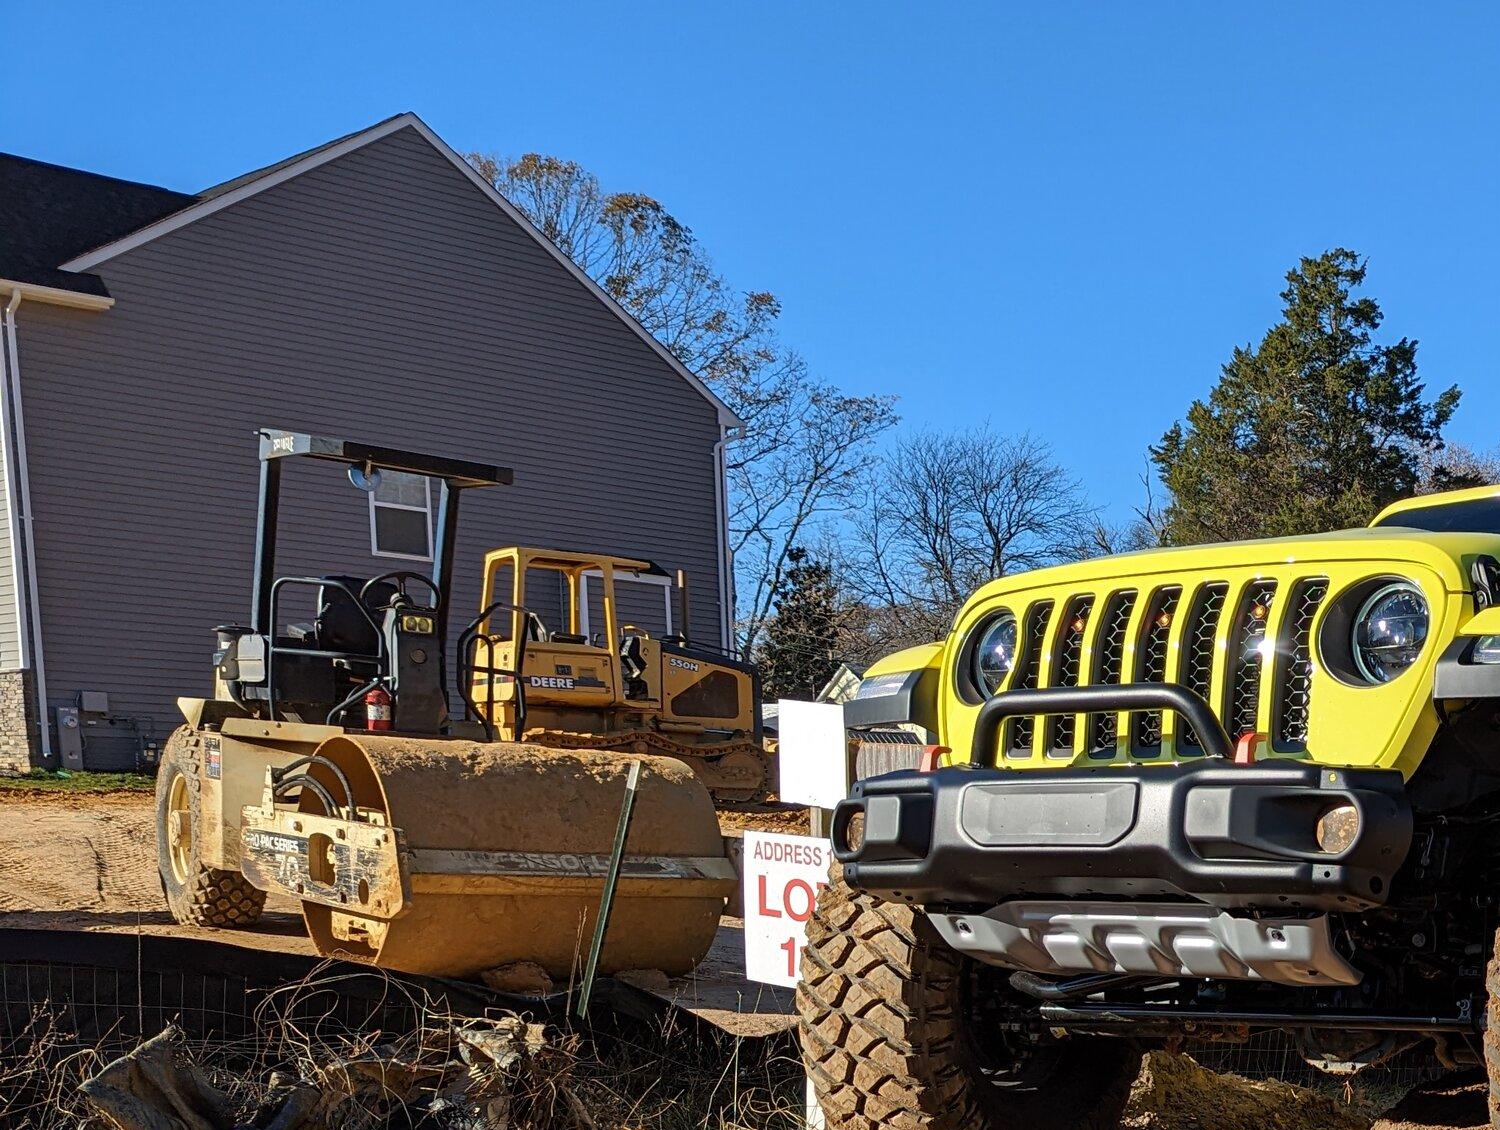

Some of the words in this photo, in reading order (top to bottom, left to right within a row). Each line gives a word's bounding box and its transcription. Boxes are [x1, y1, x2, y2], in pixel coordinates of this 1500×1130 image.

[669, 658, 699, 672] 550H
[531, 675, 575, 689] DEERE
[754, 840, 822, 867] ADDRESS
[758, 874, 829, 922] LO
